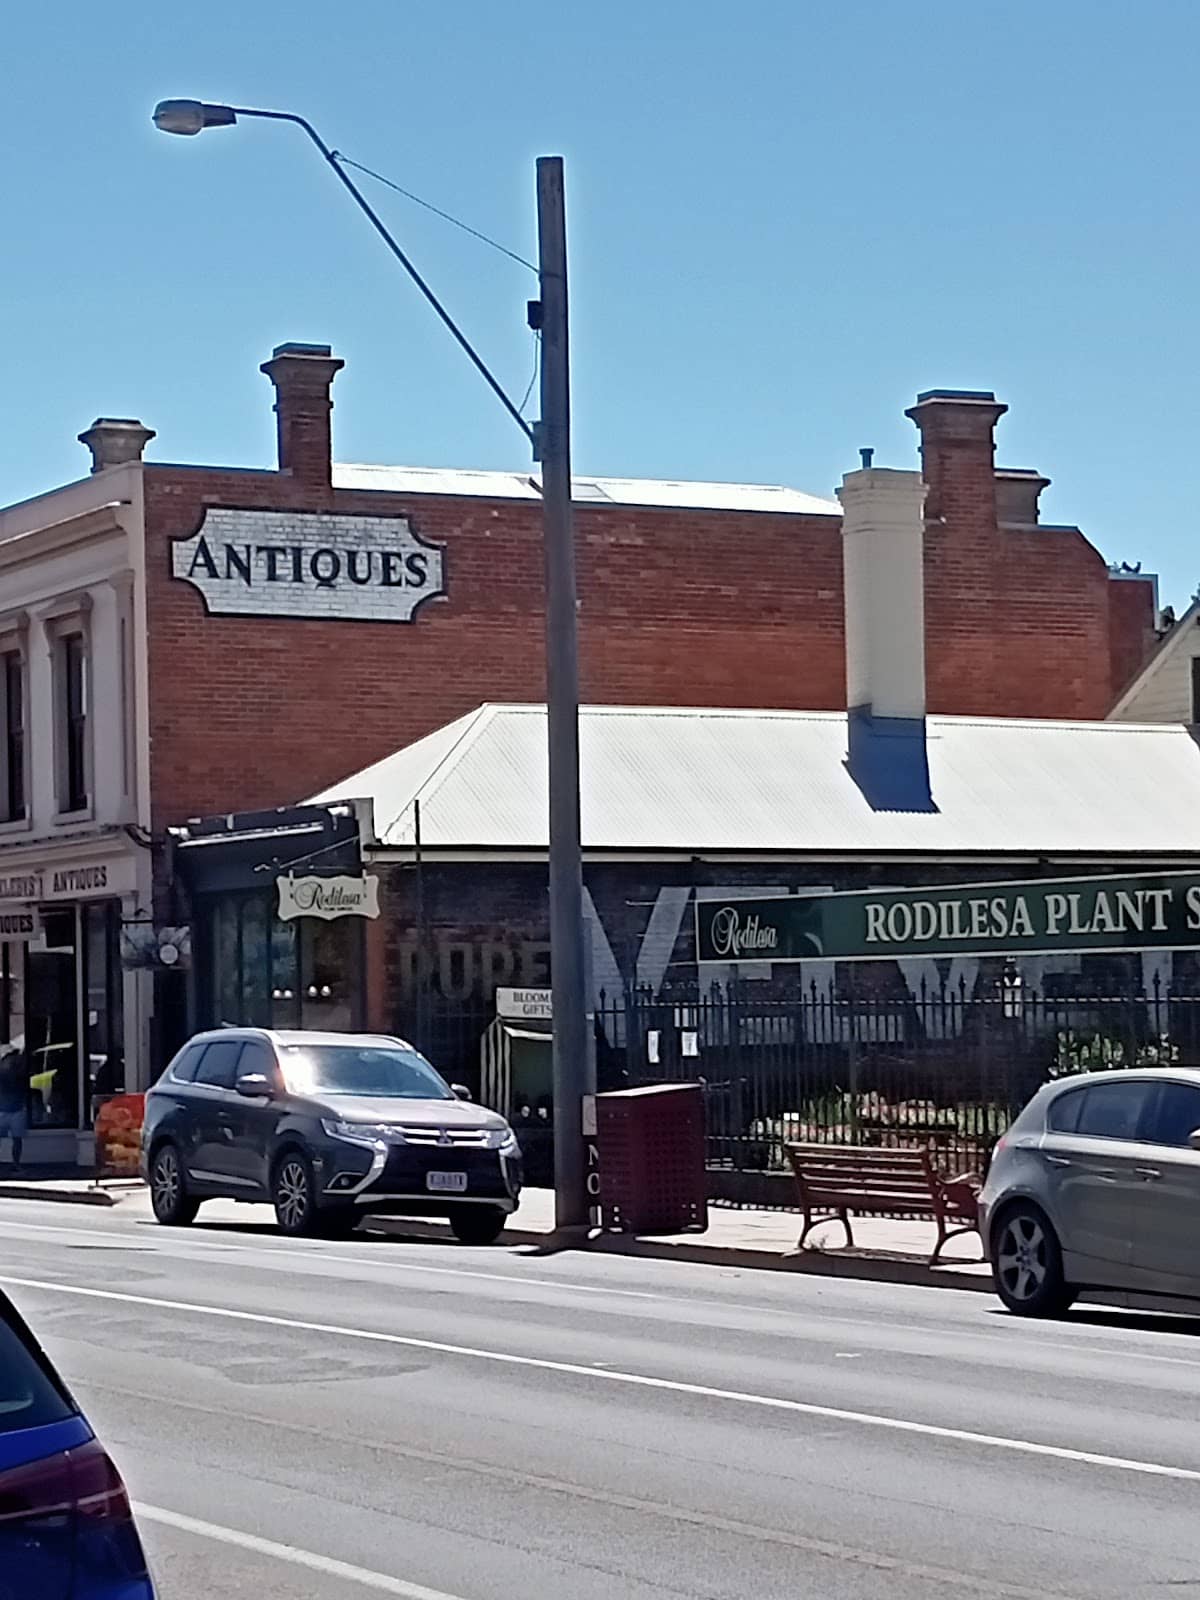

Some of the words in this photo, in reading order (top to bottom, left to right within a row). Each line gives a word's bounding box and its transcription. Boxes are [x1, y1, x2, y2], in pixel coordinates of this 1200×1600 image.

[188, 535, 428, 589] ANTIQUES
[53, 865, 107, 893] ANTIQUES
[711, 906, 778, 956] Rodilesa
[865, 896, 1035, 942] RODILESA
[1044, 889, 1173, 935] PLANT
